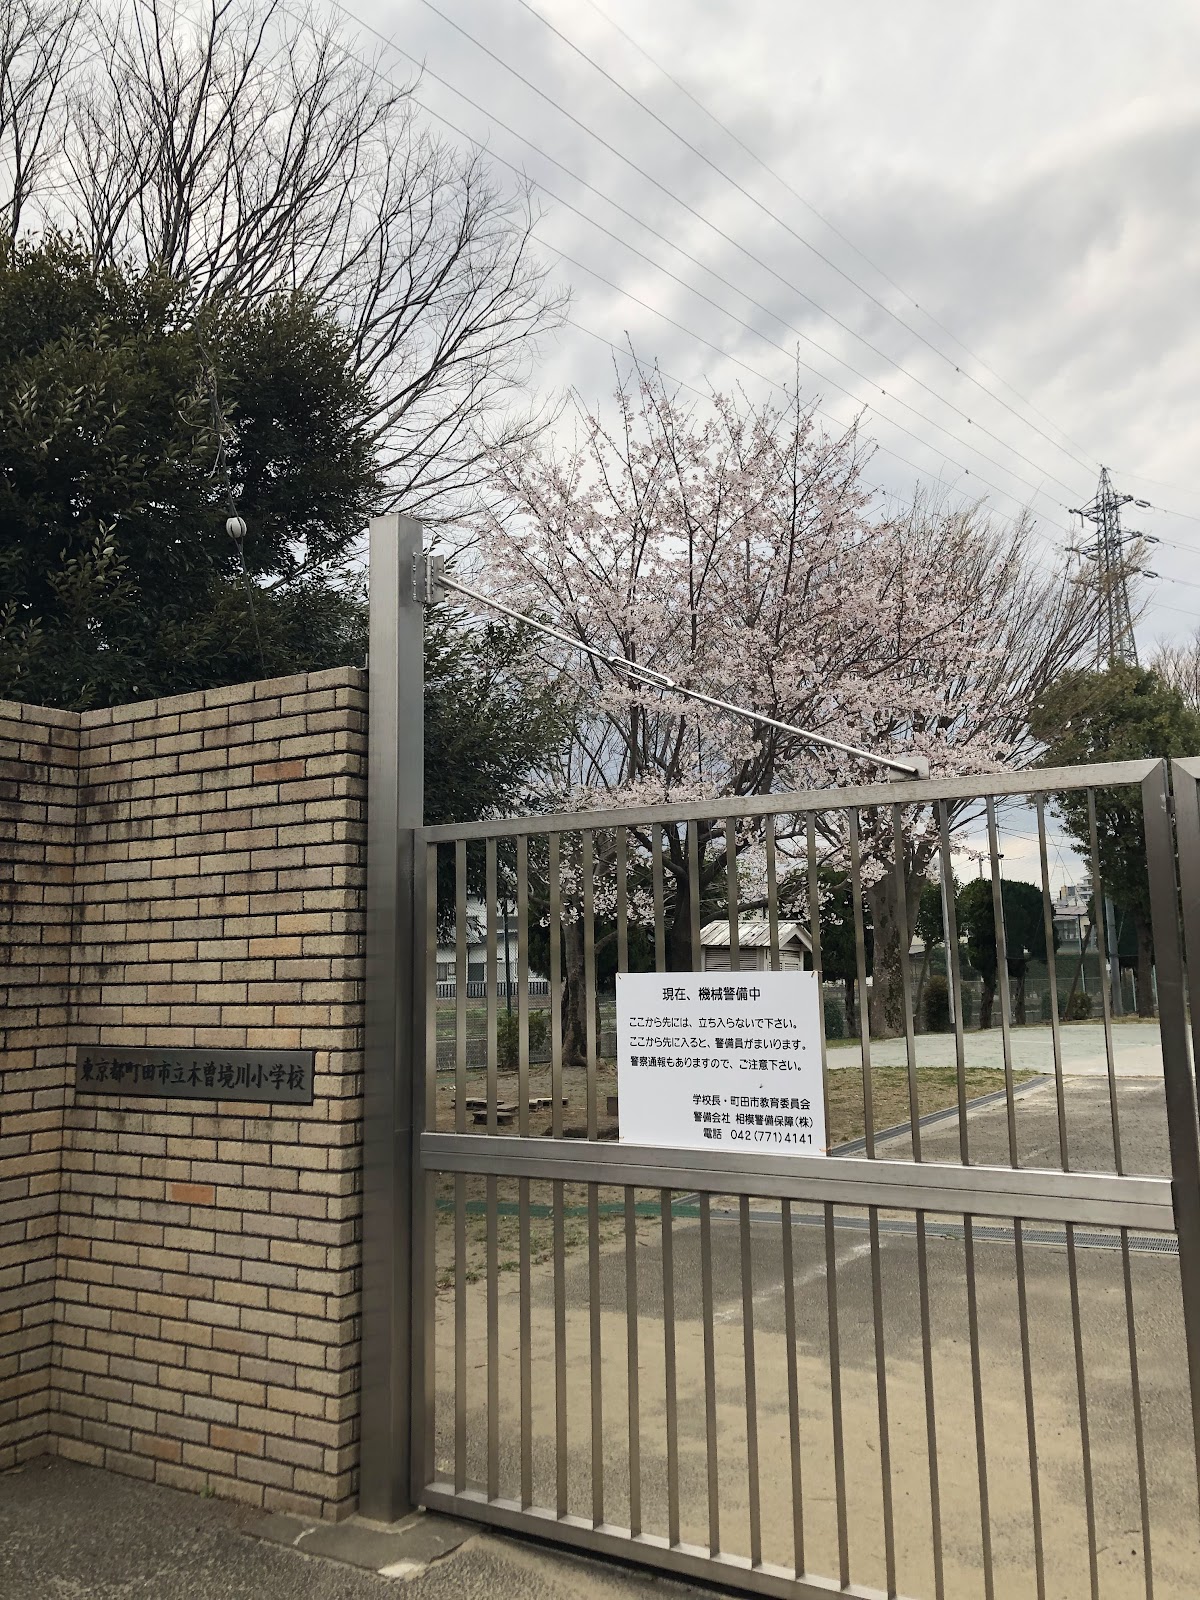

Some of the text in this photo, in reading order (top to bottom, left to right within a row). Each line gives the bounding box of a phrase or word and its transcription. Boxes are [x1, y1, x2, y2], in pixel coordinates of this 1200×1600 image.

[662, 987, 761, 1002] 現在、機械警備中
[629, 1017, 798, 1029] ここから先には、立ち入らないで下さい。
[629, 1036, 807, 1051] ここから先に入ると、警備員がまいります。
[630, 1056, 802, 1071] 警察通報もありますので、ご注意下さい。
[692, 1094, 811, 1110] 学校長・町田市教育委員会
[693, 1111, 731, 1124] 警備会社
[703, 1128, 722, 1140] 電話
